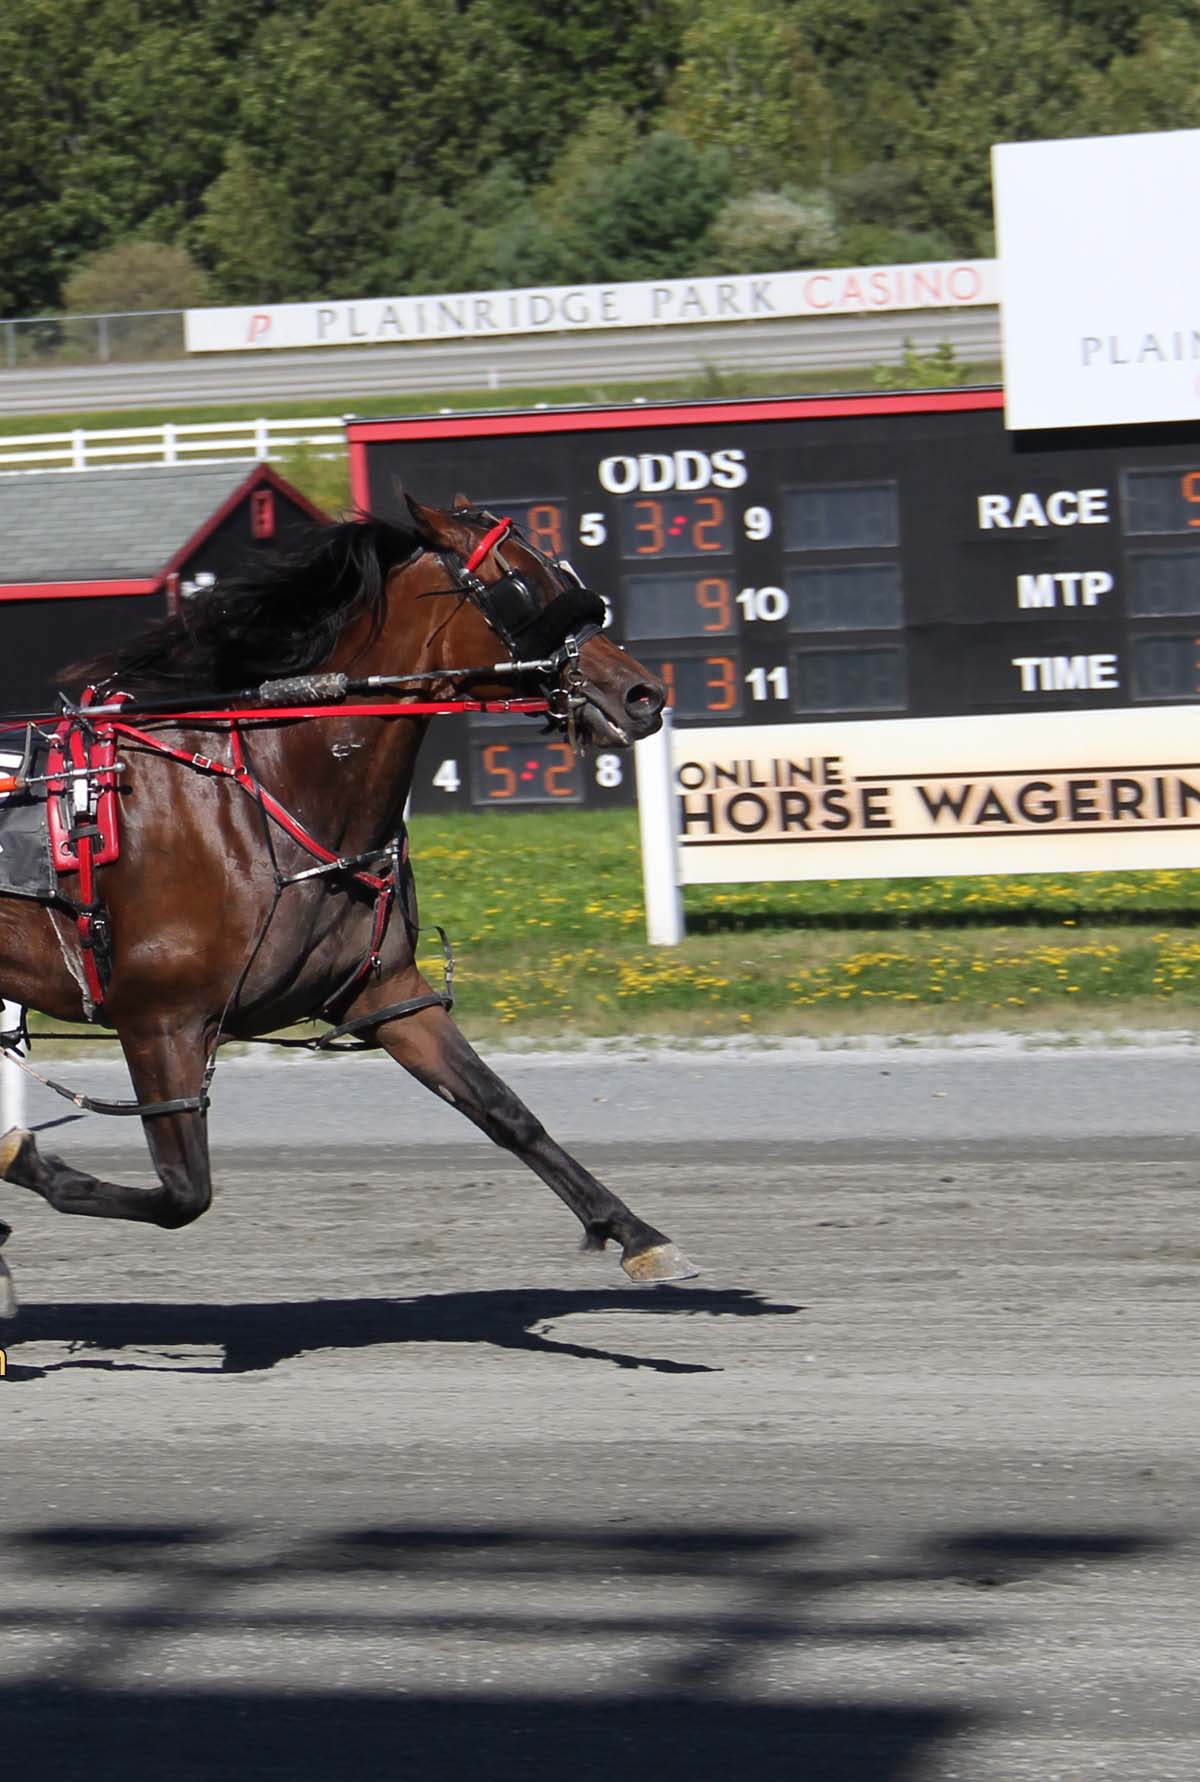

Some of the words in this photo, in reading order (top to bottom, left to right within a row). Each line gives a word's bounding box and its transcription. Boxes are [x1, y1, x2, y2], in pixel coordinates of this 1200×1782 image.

[315, 291, 622, 339] PLAINRIDGE
[651, 280, 776, 320] PARK
[803, 266, 982, 309] CASINO
[1081, 329, 1200, 366] PLAI
[599, 449, 748, 494] ODDS
[743, 506, 772, 541] 9
[977, 487, 1111, 530] RACE
[527, 504, 564, 559] 8
[579, 512, 607, 547] 5
[696, 577, 731, 632] 9
[736, 586, 790, 622] 10
[1016, 571, 1114, 609] MTP
[744, 665, 790, 701] 11
[1011, 653, 1120, 692] TIME
[432, 758, 462, 793] 4
[595, 753, 624, 788] 8
[678, 756, 844, 790] ONLINE
[679, 787, 893, 835] HORSE
[915, 777, 1200, 826] WAGERIN
